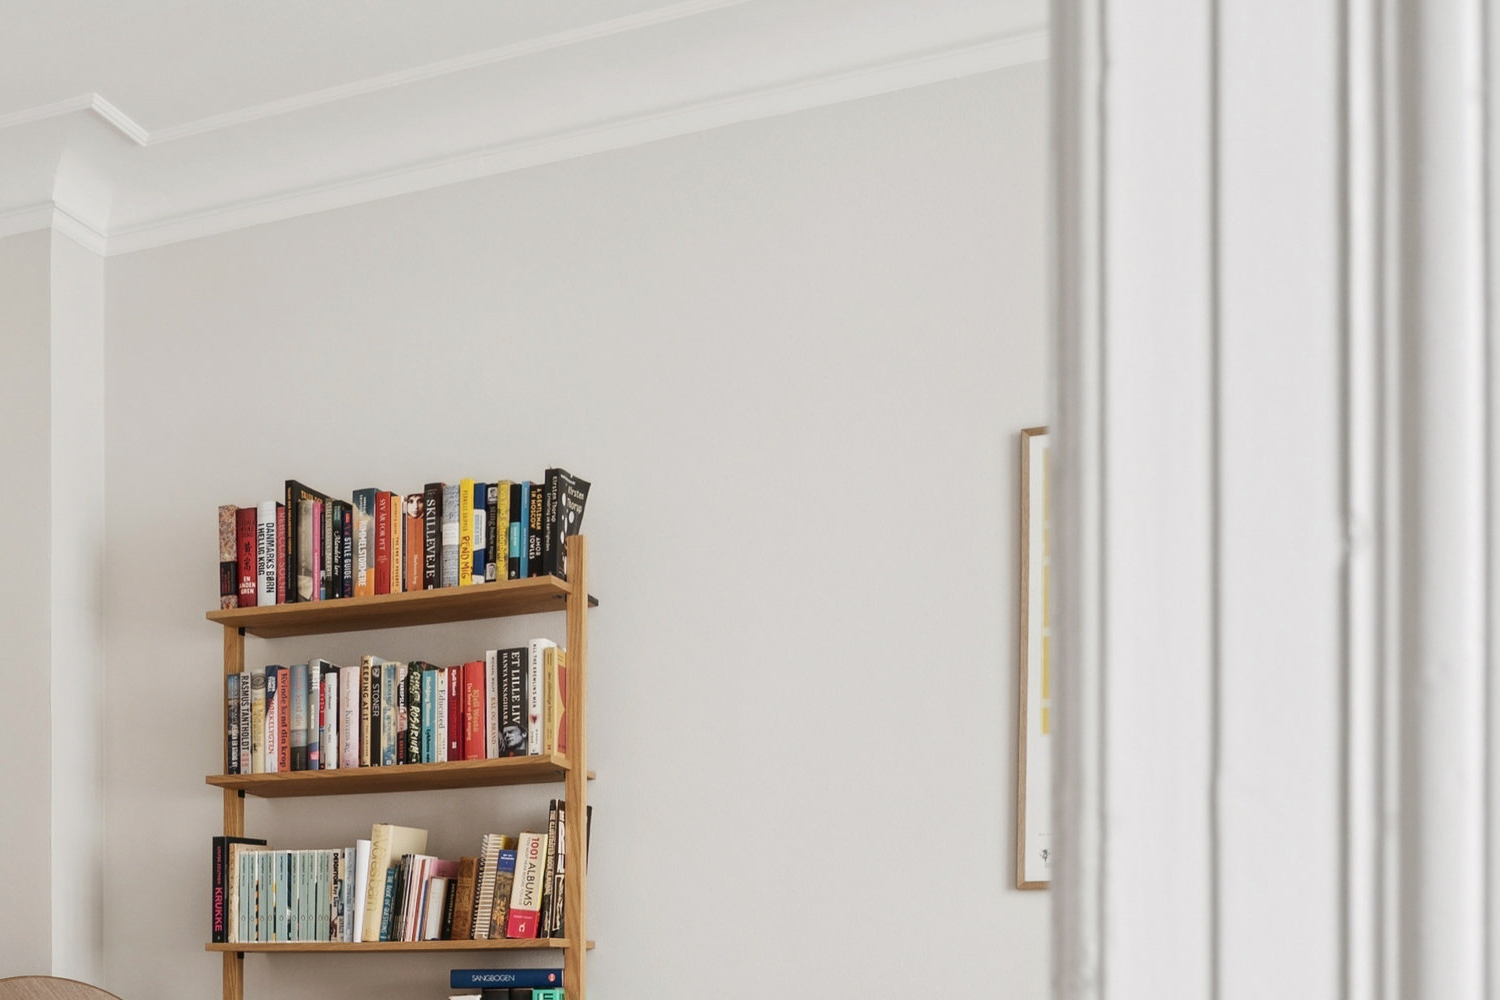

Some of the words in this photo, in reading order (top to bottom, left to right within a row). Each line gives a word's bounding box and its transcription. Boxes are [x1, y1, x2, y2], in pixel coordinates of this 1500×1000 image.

[500, 484, 508, 499] Eva
[500, 500, 508, 517] Tind
[266, 522, 274, 569] DANMARKS
[426, 499, 436, 578] SKILLEVEJE
[460, 536, 470, 560] REND
[266, 571, 275, 593] BØRN
[511, 652, 520, 666] ET
[241, 675, 249, 707] RASMUS
[280, 673, 288, 704] Kvinde
[511, 670, 520, 703] LILLE
[363, 701, 369, 711] AT
[438, 689, 446, 729] Educated
[512, 705, 520, 724] LIV
[242, 708, 250, 751] TANTHOLDT
[410, 705, 421, 753] ROSARIUM
[280, 746, 288, 768] krop
[530, 837, 540, 860] 1001
[523, 863, 536, 906] ALBUMS
[215, 887, 223, 932] KRUKKE
[472, 974, 515, 982] SANGBOGEN
